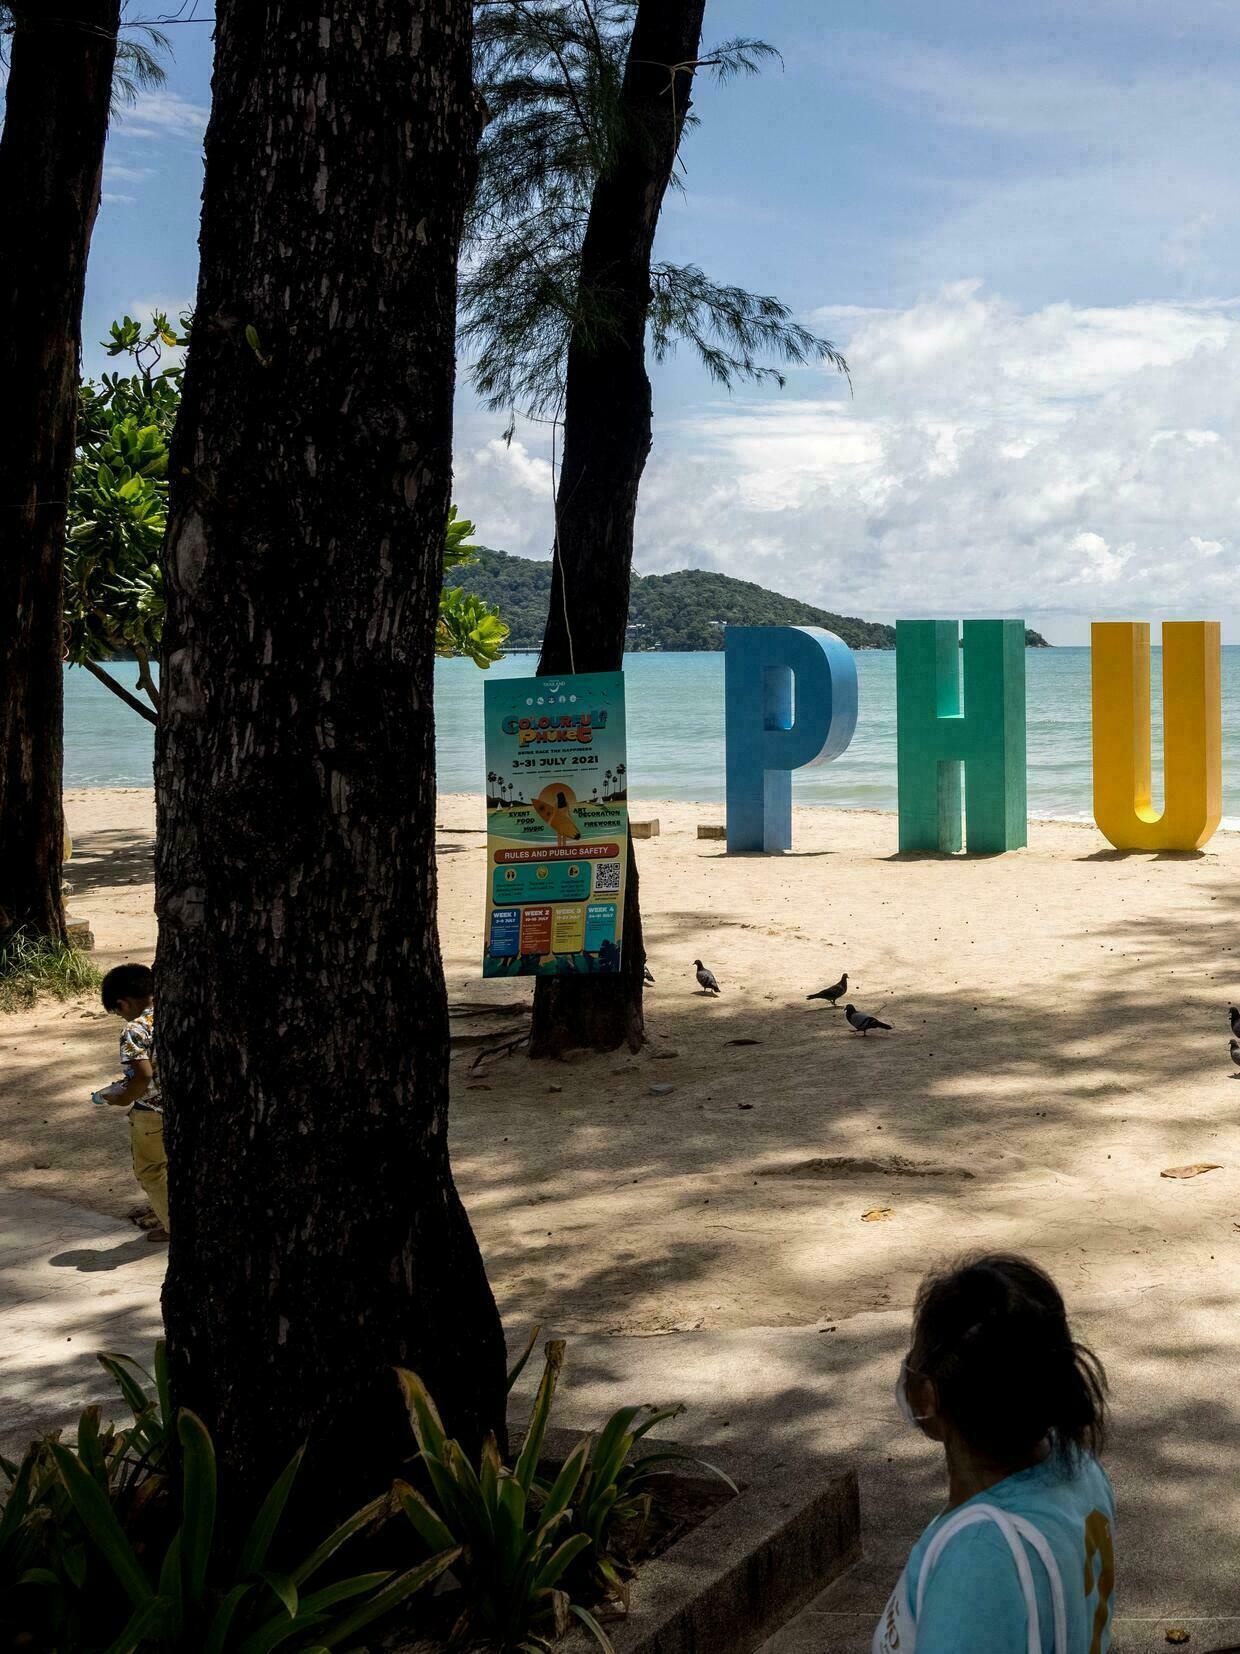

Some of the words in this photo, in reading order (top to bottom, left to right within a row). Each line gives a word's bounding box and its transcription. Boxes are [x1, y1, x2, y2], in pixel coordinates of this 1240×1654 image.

[502, 710, 607, 735] COLOURFUL
[512, 759, 536, 768] 3-31
[540, 758, 567, 767] JULY
[572, 756, 599, 765] 2021
[578, 810, 621, 819] DECORATION
[523, 825, 545, 833] MUSIC
[584, 820, 621, 828] FIREWORKS
[504, 850, 530, 860] RULES
[531, 850, 548, 858] AND
[549, 848, 578, 857] PUBLIC
[579, 847, 609, 856] SAFETY
